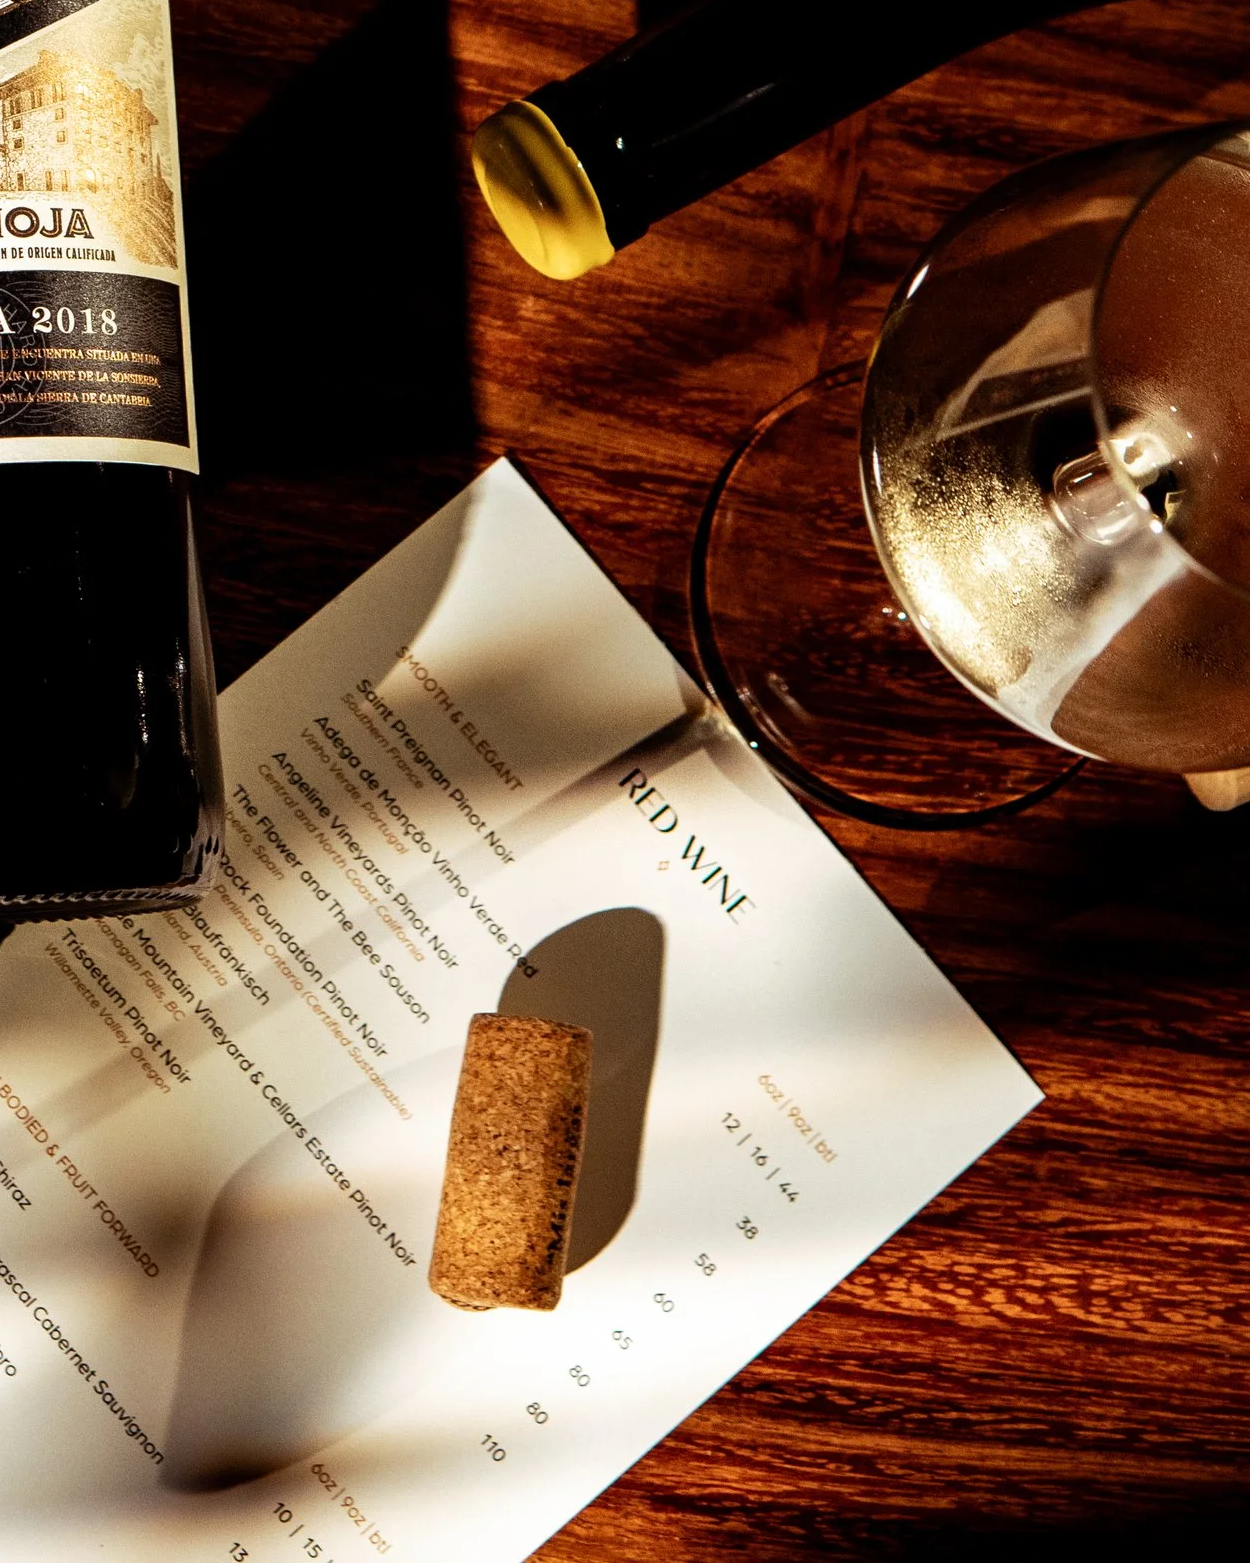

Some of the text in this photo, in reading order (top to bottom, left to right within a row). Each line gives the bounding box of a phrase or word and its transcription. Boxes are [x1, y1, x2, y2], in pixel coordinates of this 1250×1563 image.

[11, 247, 24, 259] DE
[27, 246, 63, 259] ORIGEN
[66, 247, 117, 262] CALIFICADA
[32, 305, 119, 337] 2018
[355, 678, 514, 864] Saint Preignan Pinot Noir
[393, 644, 524, 791] SMOOTH & ELEGANT
[231, 782, 430, 1024] The Flower and The Bee Souson
[269, 751, 458, 968] Angeline Vineyards Pinot Noir
[311, 716, 540, 980] Adega de Monção Vinho Verde Red
[617, 766, 756, 925] RED WINE
[61, 926, 191, 1084] Trisaetum Pinot Noir
[180, 899, 270, 1006] Blaufränkisch
[216, 851, 388, 1057] Rock Foundation Pinot Noir
[130, 927, 417, 1266] Mountain Vineyard & Cellars Estate Pinot Noir
[721, 1111, 800, 1203] 12 16 44
[45, 1143, 60, 1158] &
[55, 1154, 99, 1200] FRUIT
[91, 1199, 160, 1278] FORWARD
[693, 1252, 717, 1277] 58
[735, 1215, 759, 1240] 38
[611, 1329, 634, 1351] 65
[652, 1291, 675, 1313] 60
[32, 1305, 97, 1383] Cabernet
[92, 1379, 165, 1466] Sauvignon
[525, 1401, 549, 1425] 80
[568, 1364, 591, 1388] 80
[480, 1433, 507, 1463] 110
